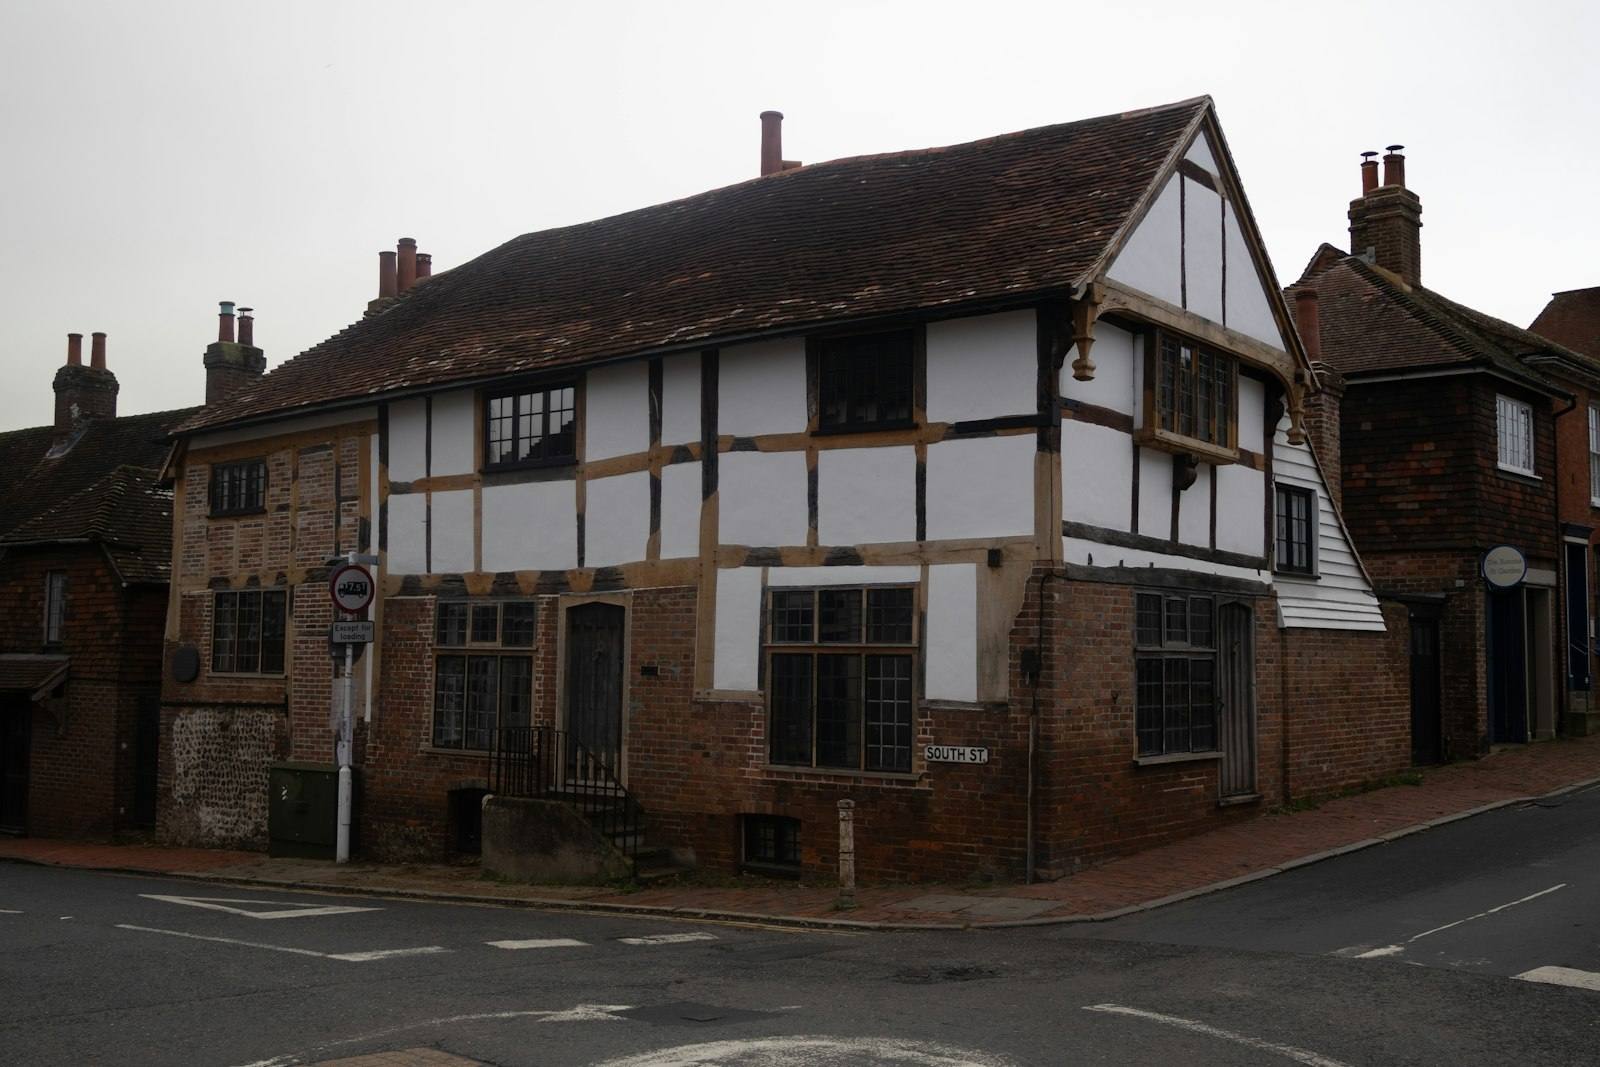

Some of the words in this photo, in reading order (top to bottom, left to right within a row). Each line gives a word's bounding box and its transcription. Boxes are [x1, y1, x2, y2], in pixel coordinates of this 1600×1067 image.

[335, 624, 358, 632] Except
[340, 632, 365, 641] loading
[927, 747, 965, 760] SOUTH
